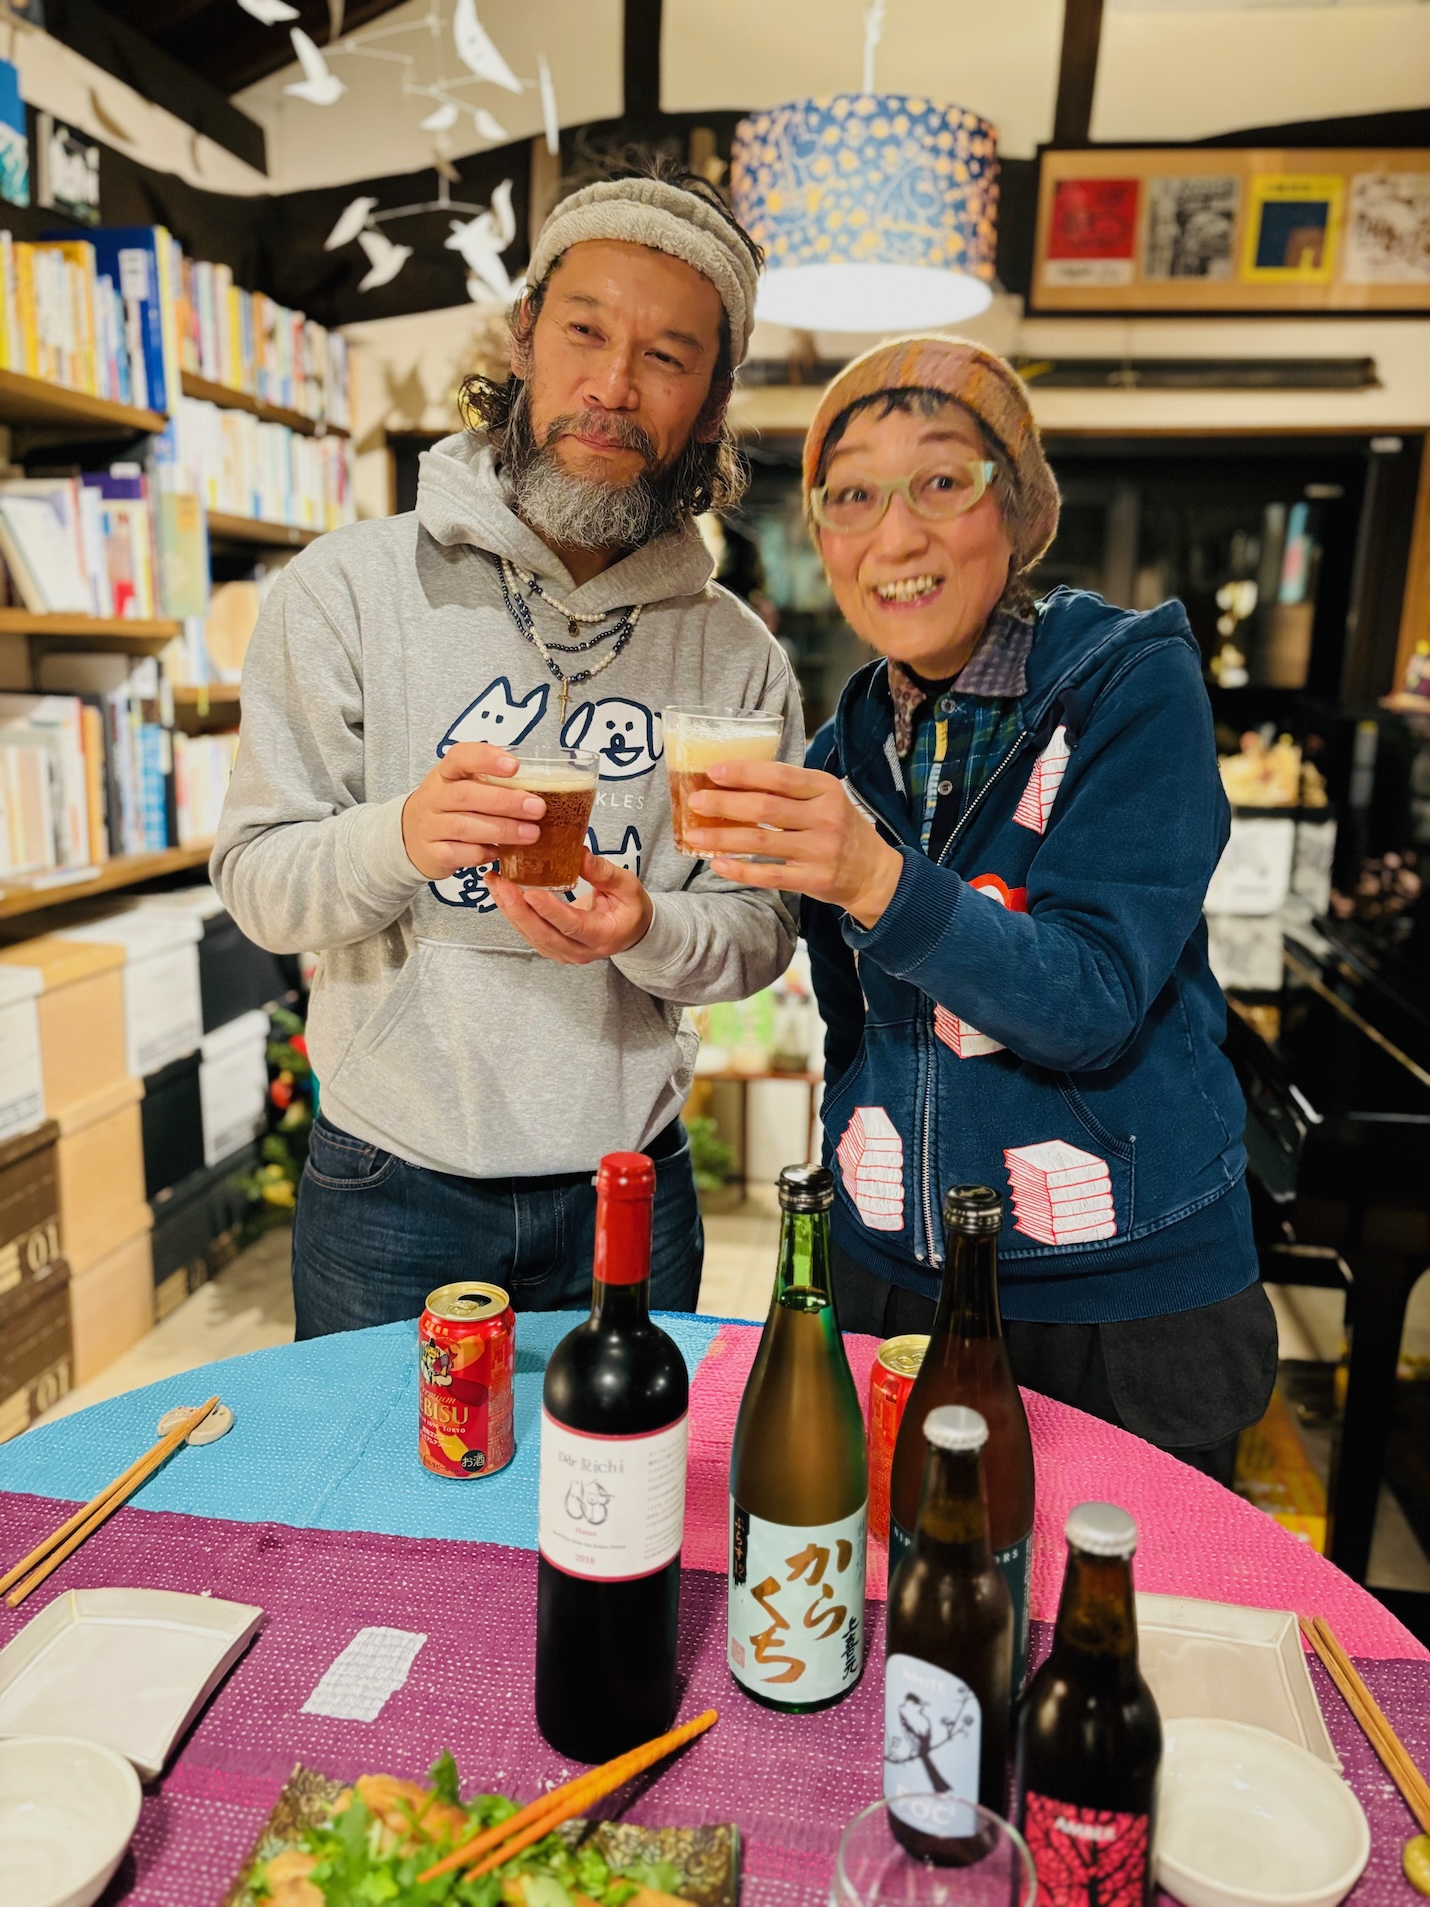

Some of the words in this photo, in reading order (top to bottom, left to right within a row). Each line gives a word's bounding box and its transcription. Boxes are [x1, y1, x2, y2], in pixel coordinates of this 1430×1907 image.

[596, 792, 644, 810] KLES
[442, 1426, 466, 1434] TOKYO
[461, 1452, 485, 1467] お酒
[581, 1457, 624, 1474] Richi
